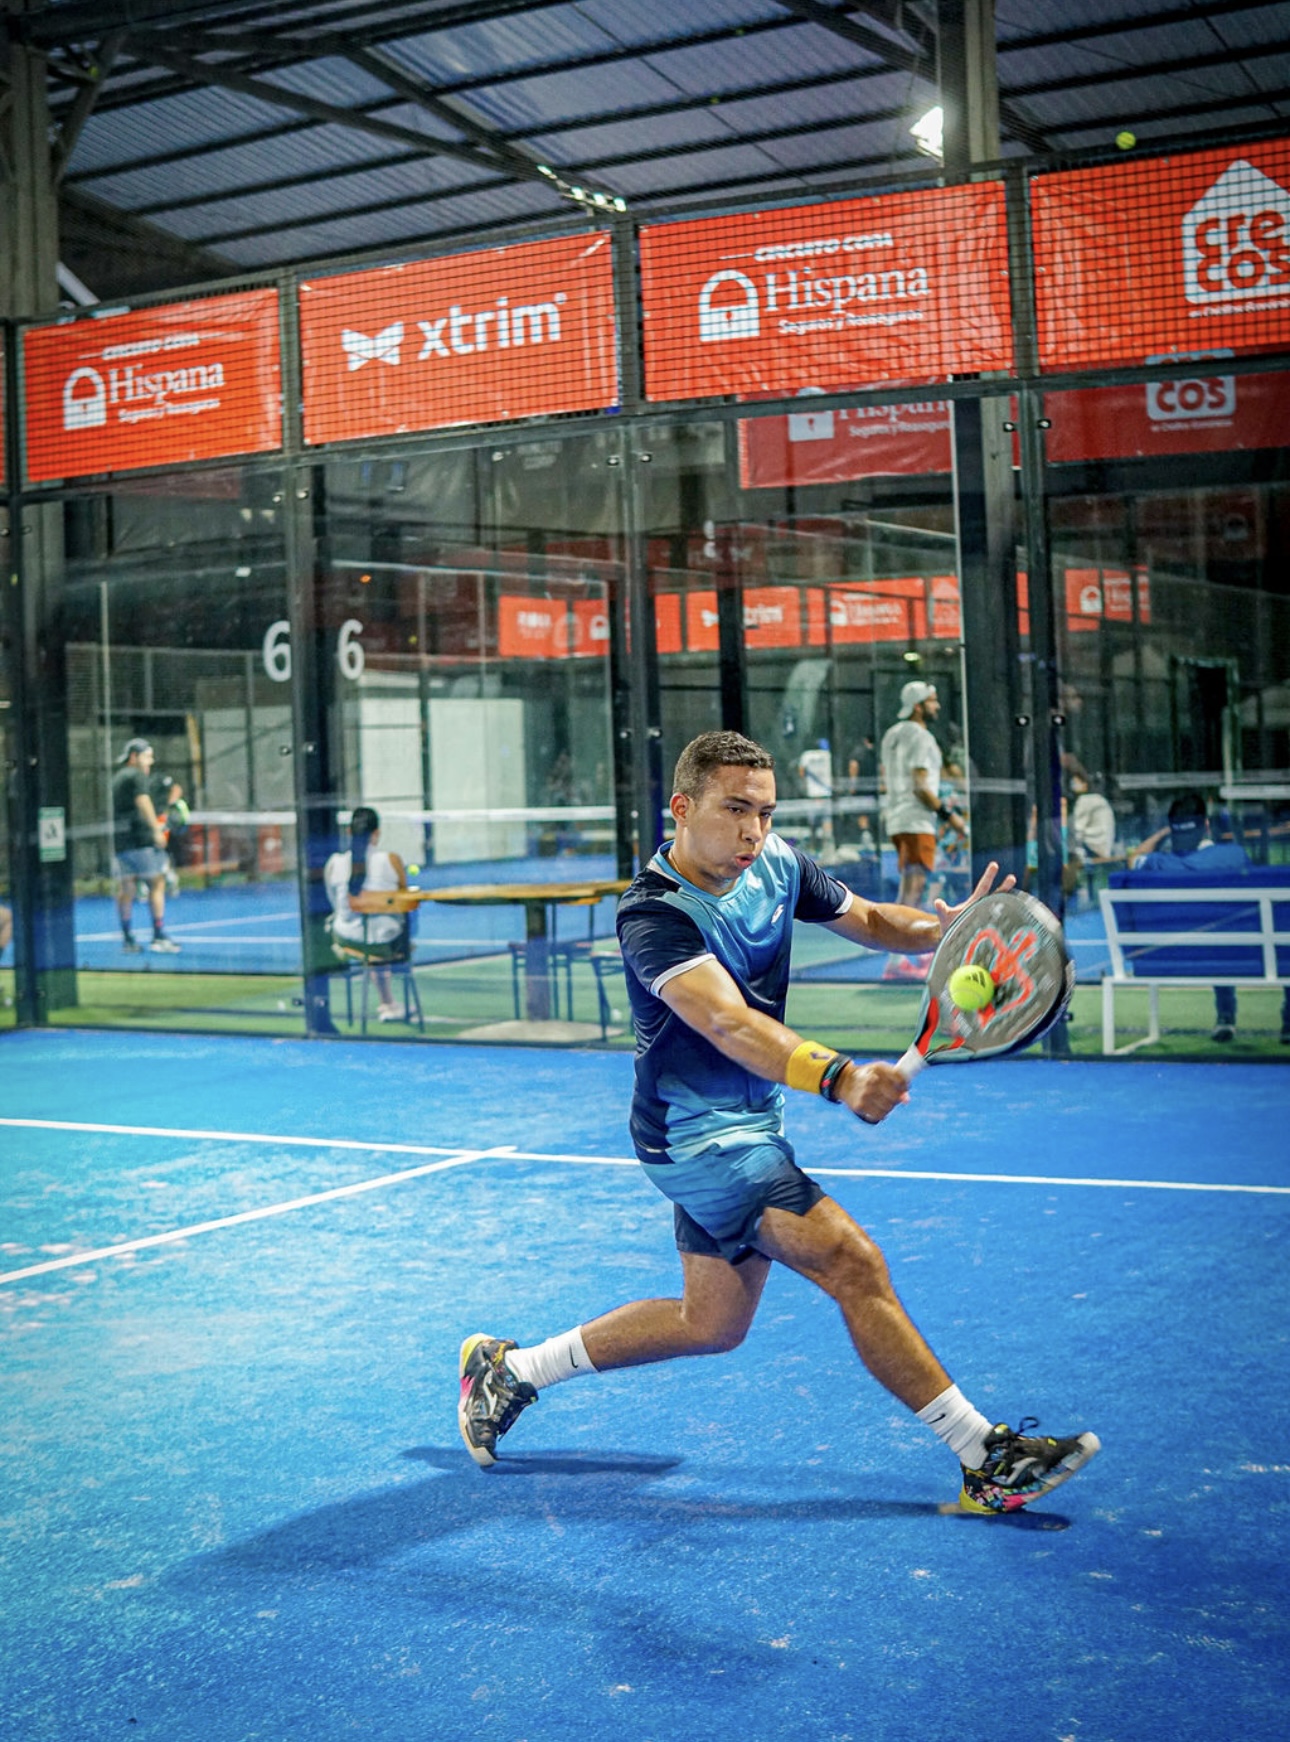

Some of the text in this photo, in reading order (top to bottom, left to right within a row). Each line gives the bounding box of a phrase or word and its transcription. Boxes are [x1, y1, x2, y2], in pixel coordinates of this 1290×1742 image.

[765, 266, 931, 314] Hispana
[417, 296, 562, 361] xtrim
[109, 362, 226, 405] Hispana
[263, 620, 292, 682] 6
[338, 618, 364, 680] 6
